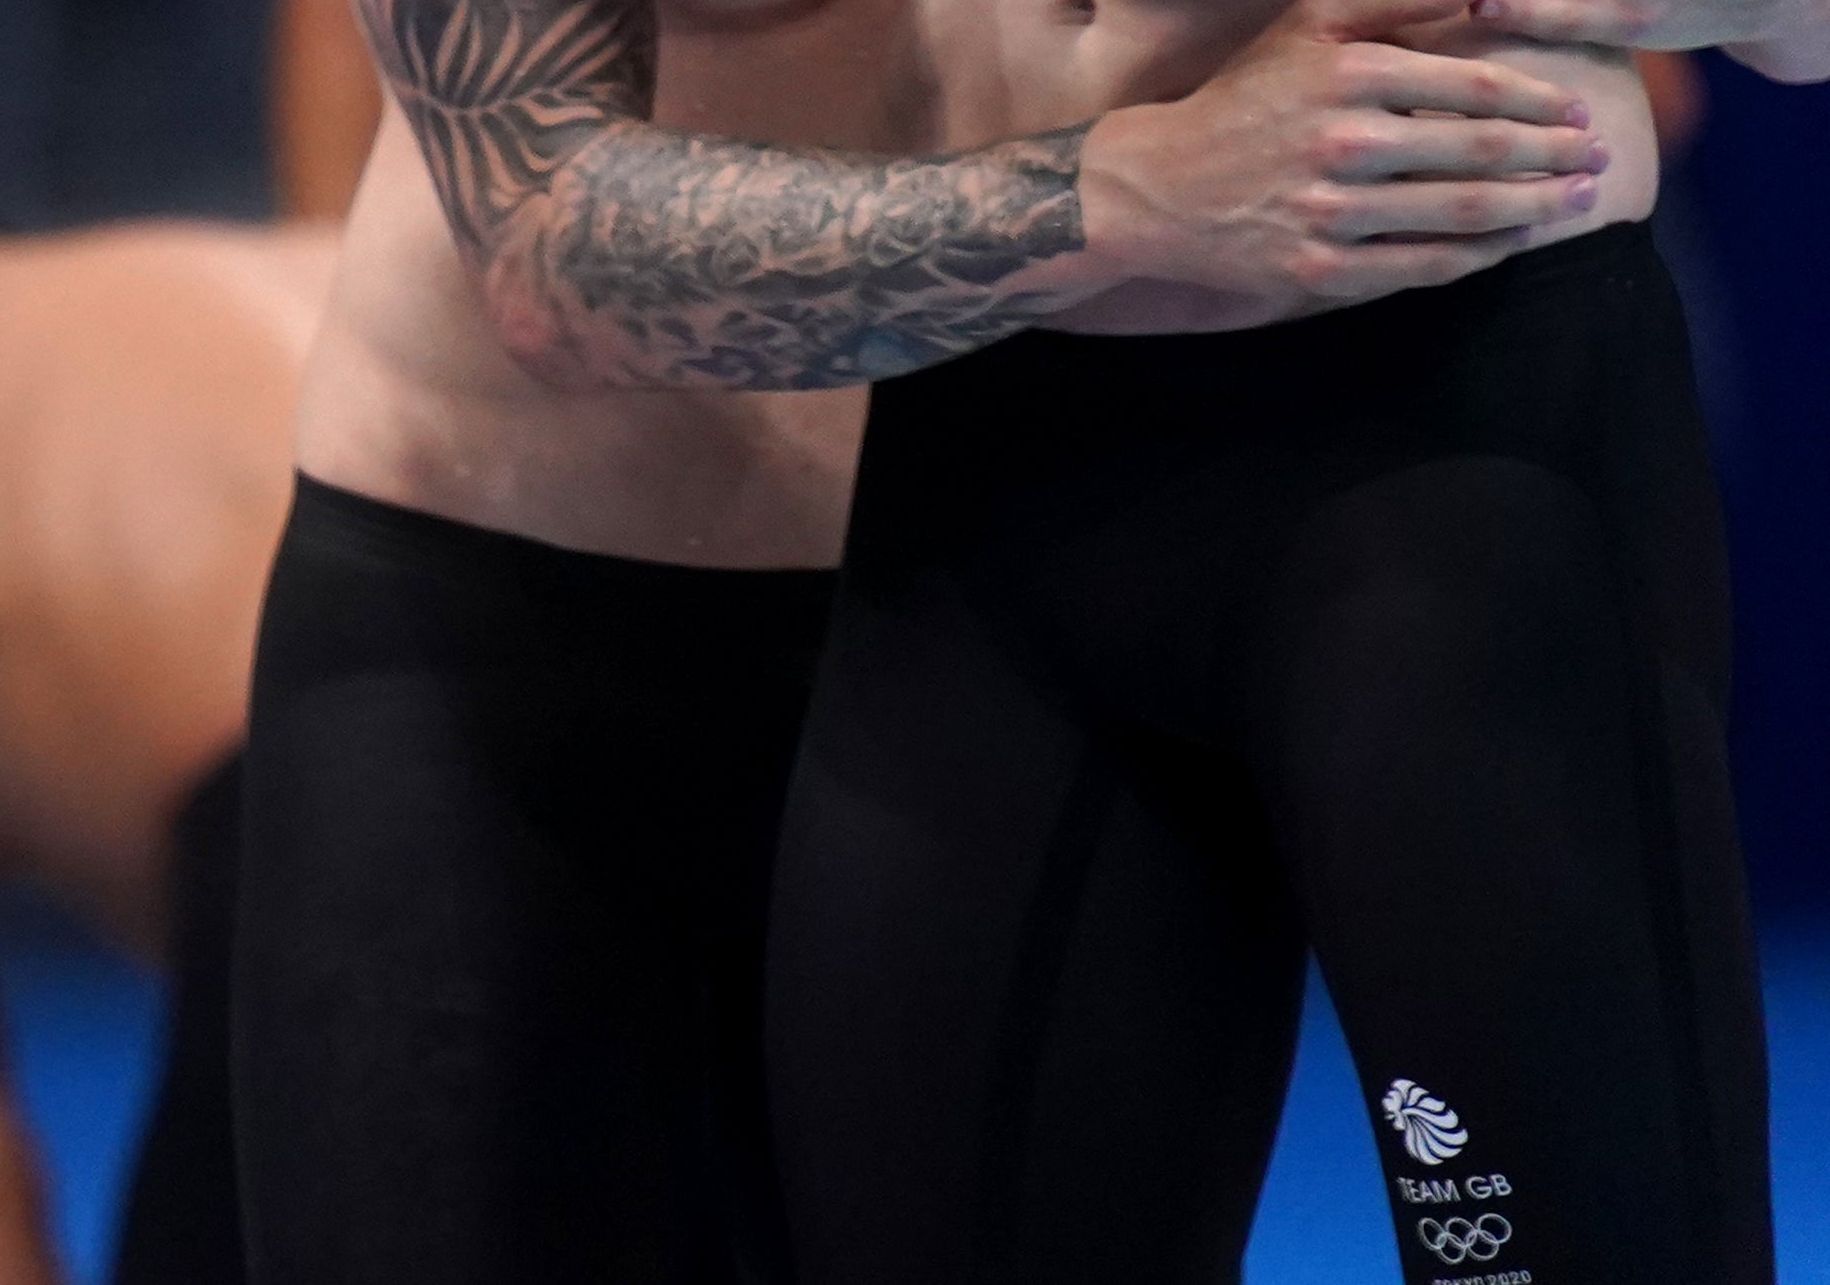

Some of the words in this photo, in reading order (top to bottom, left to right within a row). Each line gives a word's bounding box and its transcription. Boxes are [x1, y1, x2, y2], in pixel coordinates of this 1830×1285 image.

[1397, 1176, 1461, 1203] TEAM
[1465, 1173, 1513, 1200] GB
[1485, 1269, 1532, 1285] 2020
